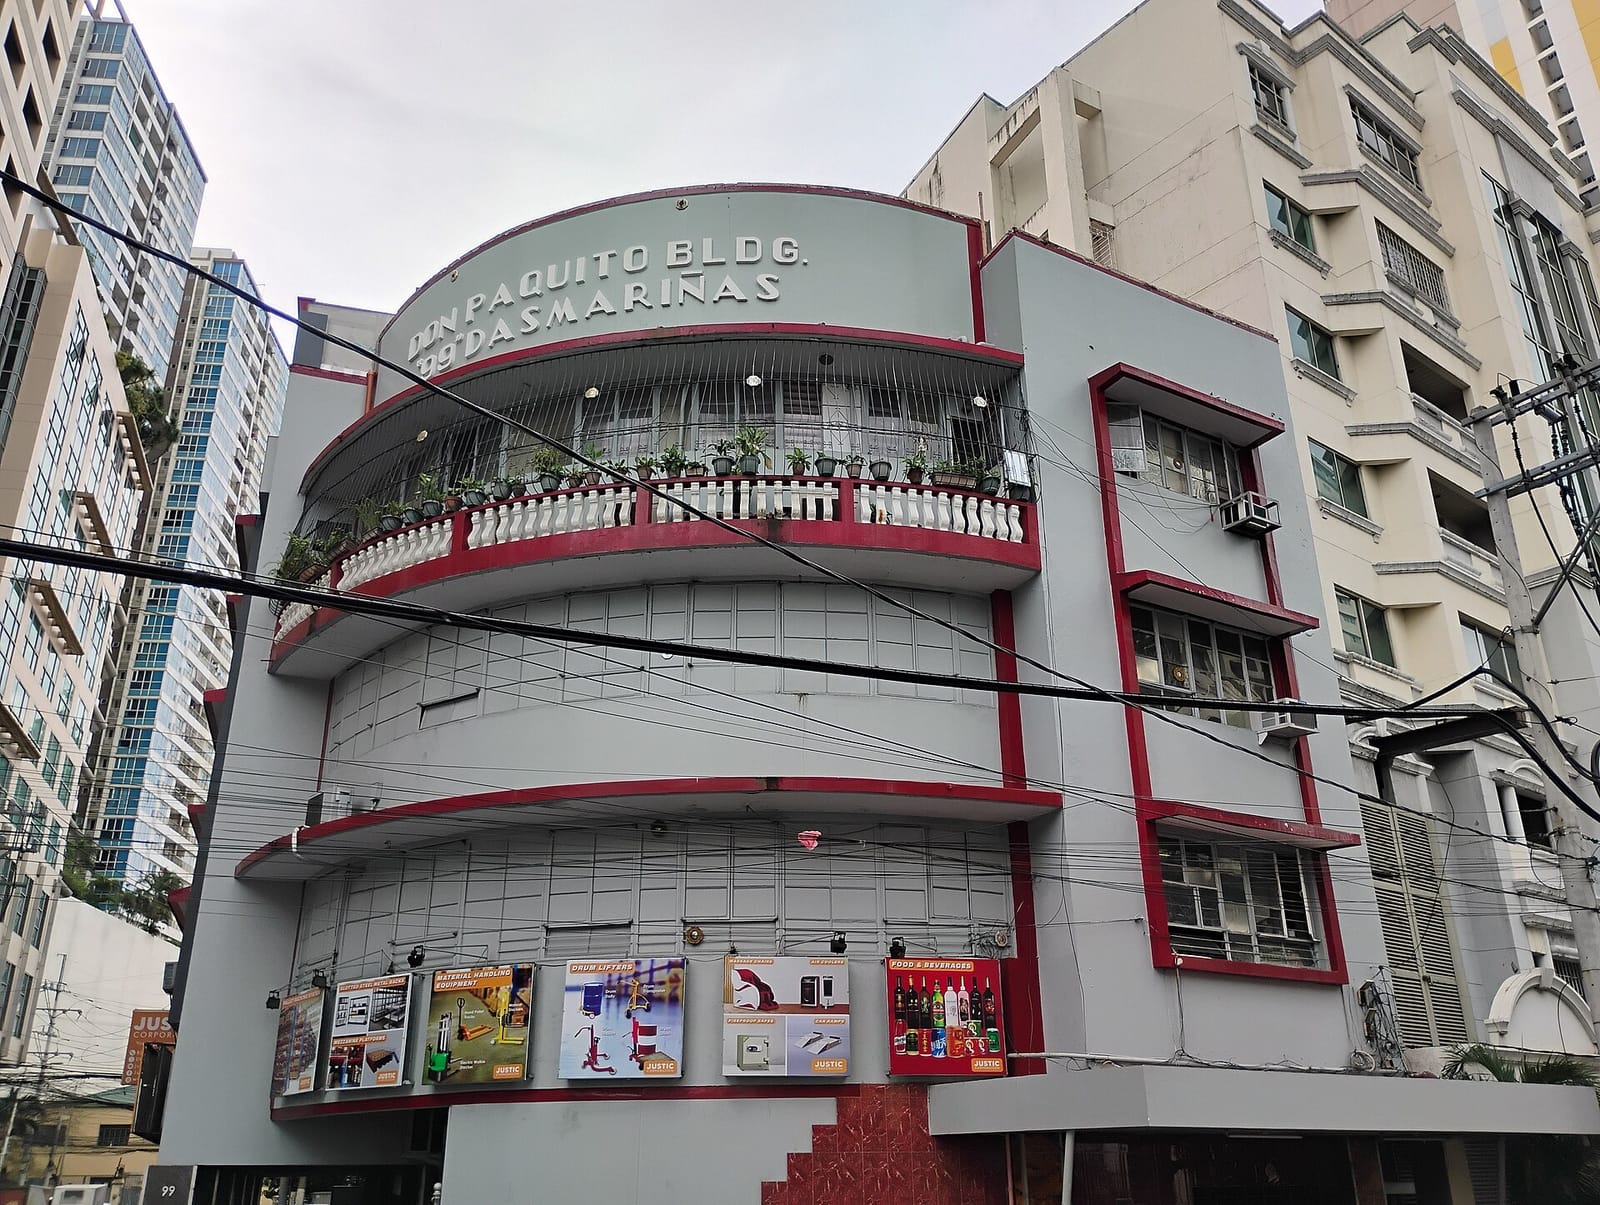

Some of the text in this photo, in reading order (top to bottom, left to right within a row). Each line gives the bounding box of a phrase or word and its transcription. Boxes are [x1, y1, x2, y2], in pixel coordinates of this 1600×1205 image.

[408, 235, 809, 362] DON PAQUITO BLDG.
[465, 270, 781, 360] DASMARIÑAS
[598, 963, 633, 971] LIFTERS
[891, 961, 914, 969] FOOD
[924, 962, 972, 970] BEVERAGES
[436, 969, 511, 981] MATERIAL HANDLING
[436, 980, 478, 989] EQUIPMENT
[496, 1066, 520, 1074] JUSTIC
[161, 1185, 176, 1197] 99
